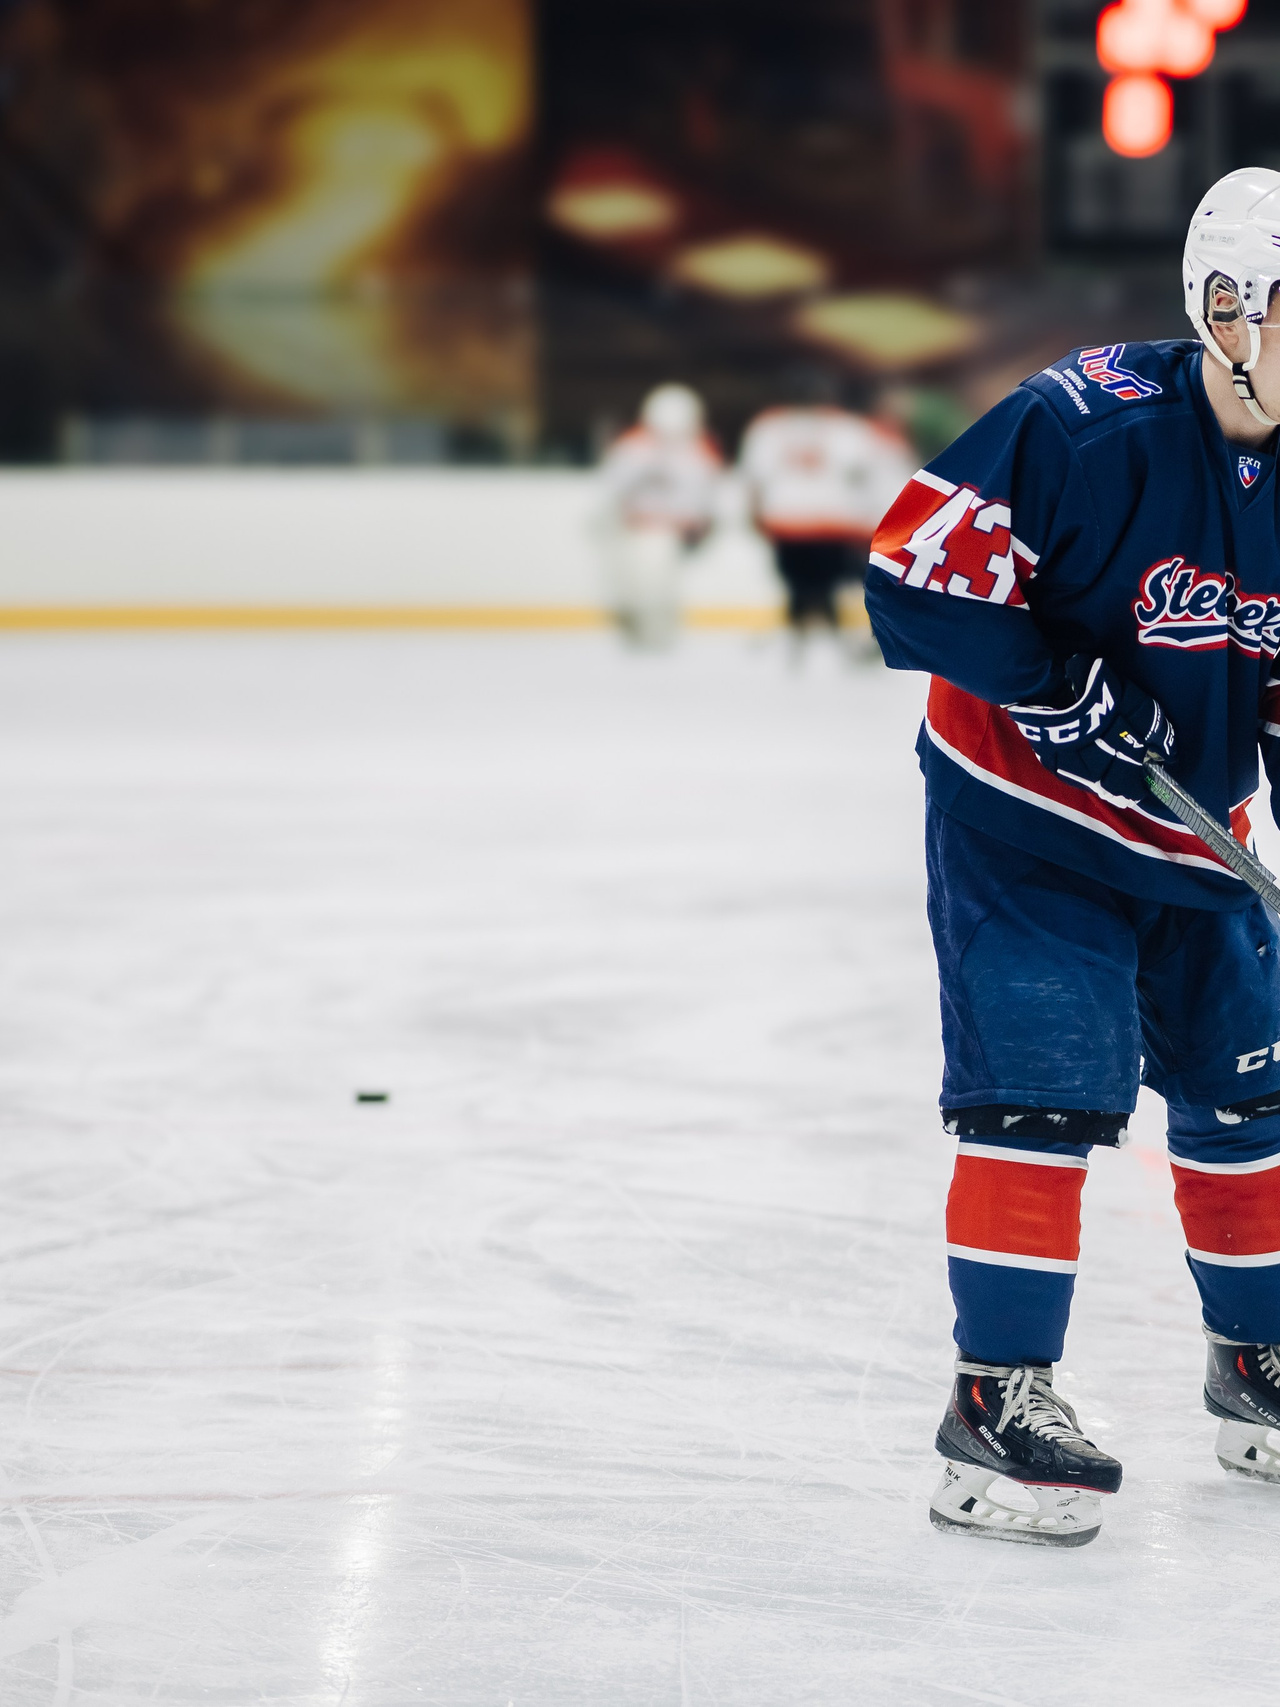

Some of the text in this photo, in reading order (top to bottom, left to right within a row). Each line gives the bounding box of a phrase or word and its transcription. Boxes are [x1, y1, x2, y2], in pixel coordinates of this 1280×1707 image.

[1059, 378, 1091, 415] COMPANY
[1062, 367, 1087, 391] MINING
[901, 486, 1017, 605] 43
[1014, 681, 1115, 744] CCM
